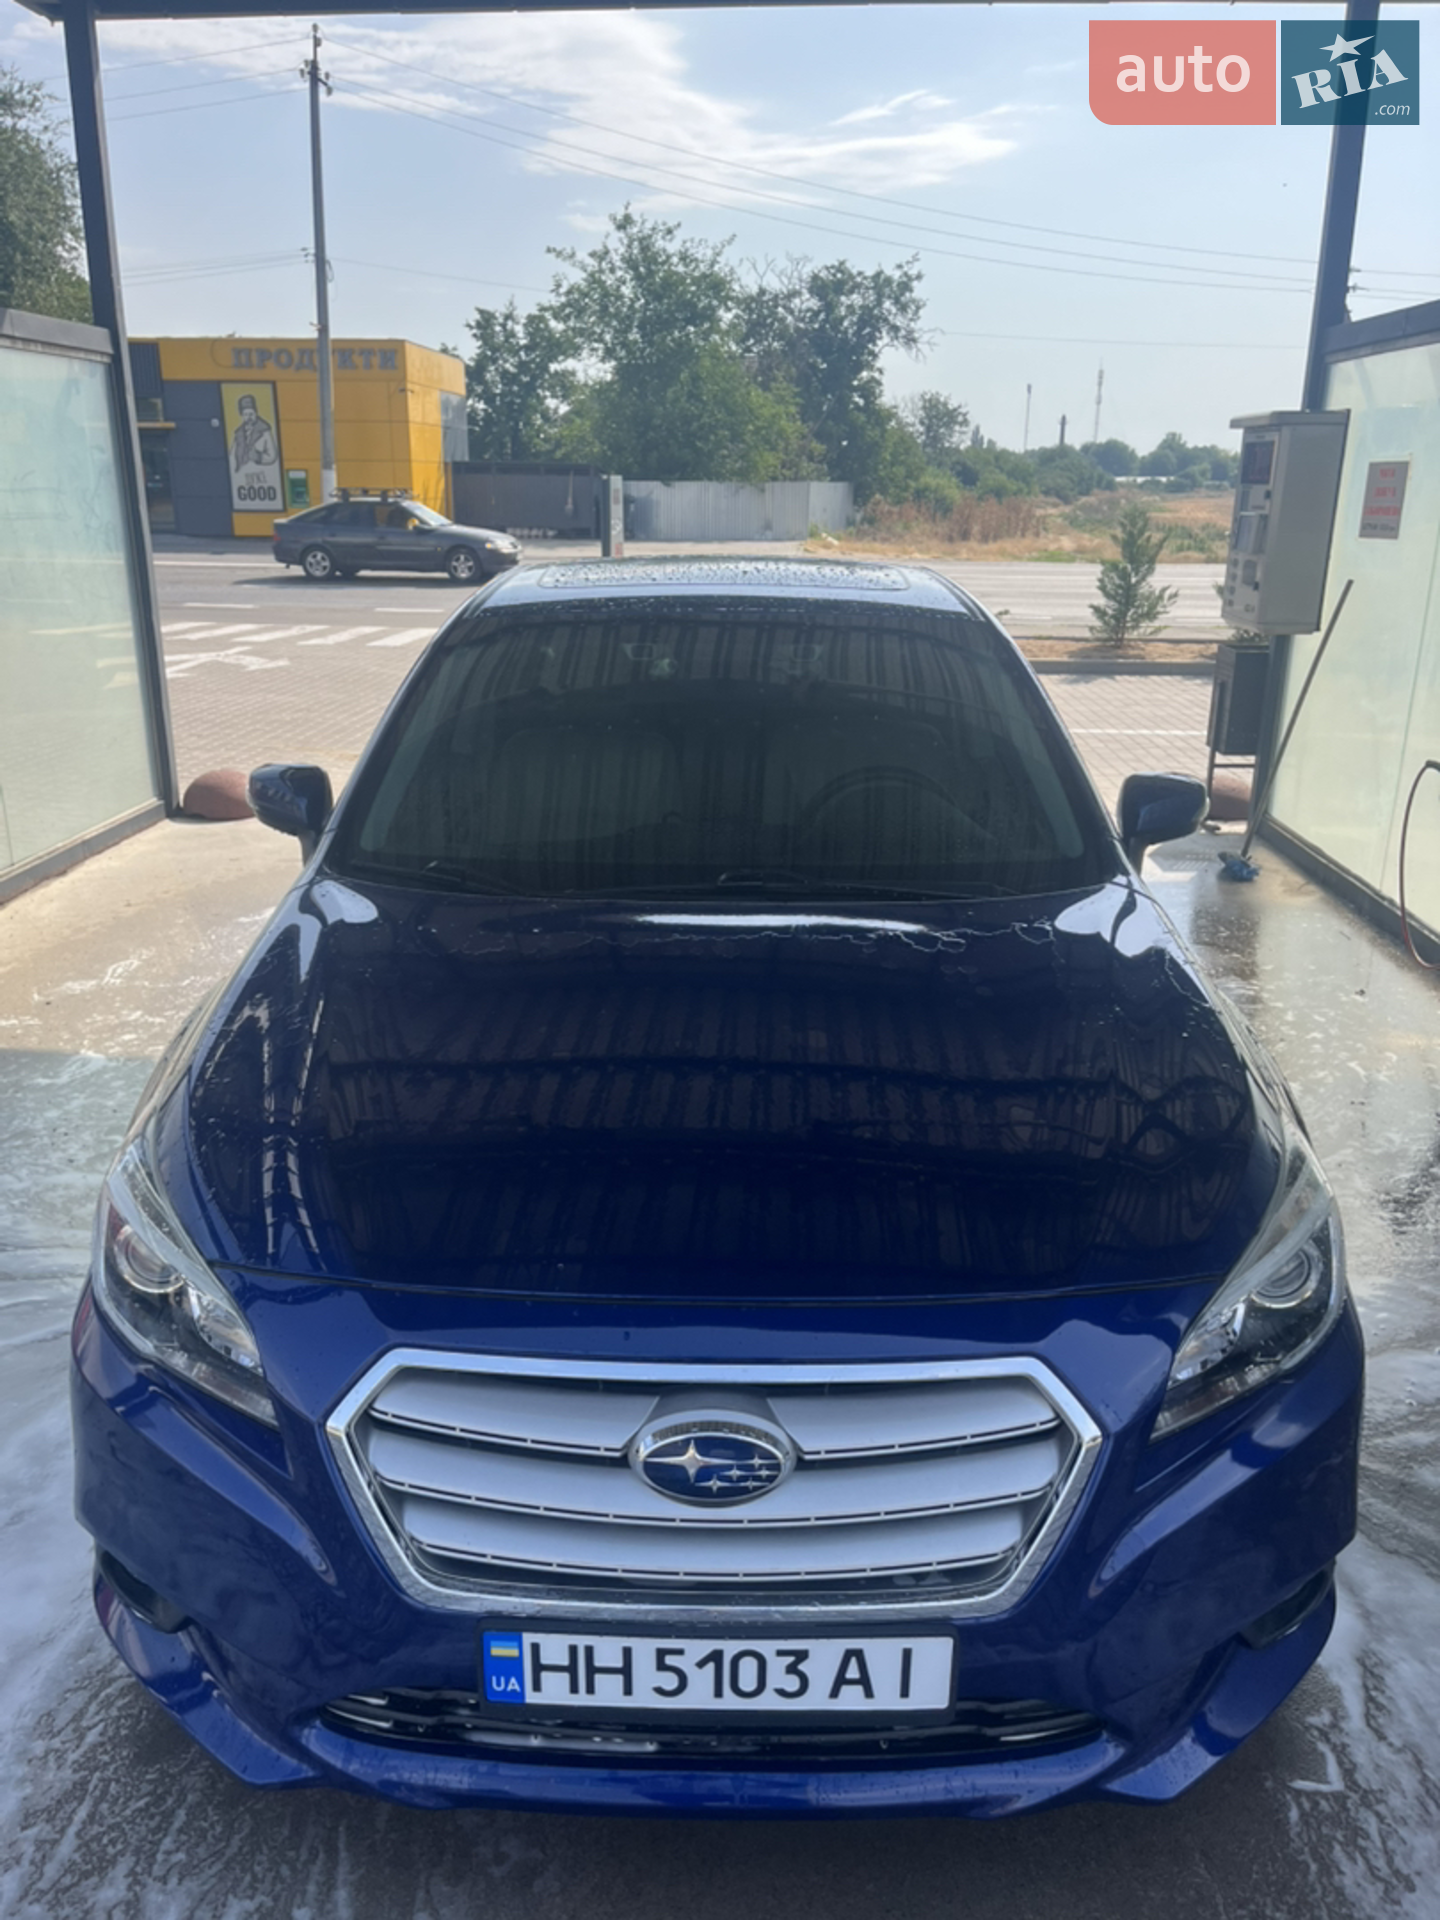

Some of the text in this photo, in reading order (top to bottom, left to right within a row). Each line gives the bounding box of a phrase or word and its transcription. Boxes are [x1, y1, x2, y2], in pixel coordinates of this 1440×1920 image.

[231, 347, 398, 371] ПРОДКТИ
[237, 485, 277, 501] GOOD
[652, 1648, 809, 1699] 5103
[491, 1676, 521, 1692] UA
